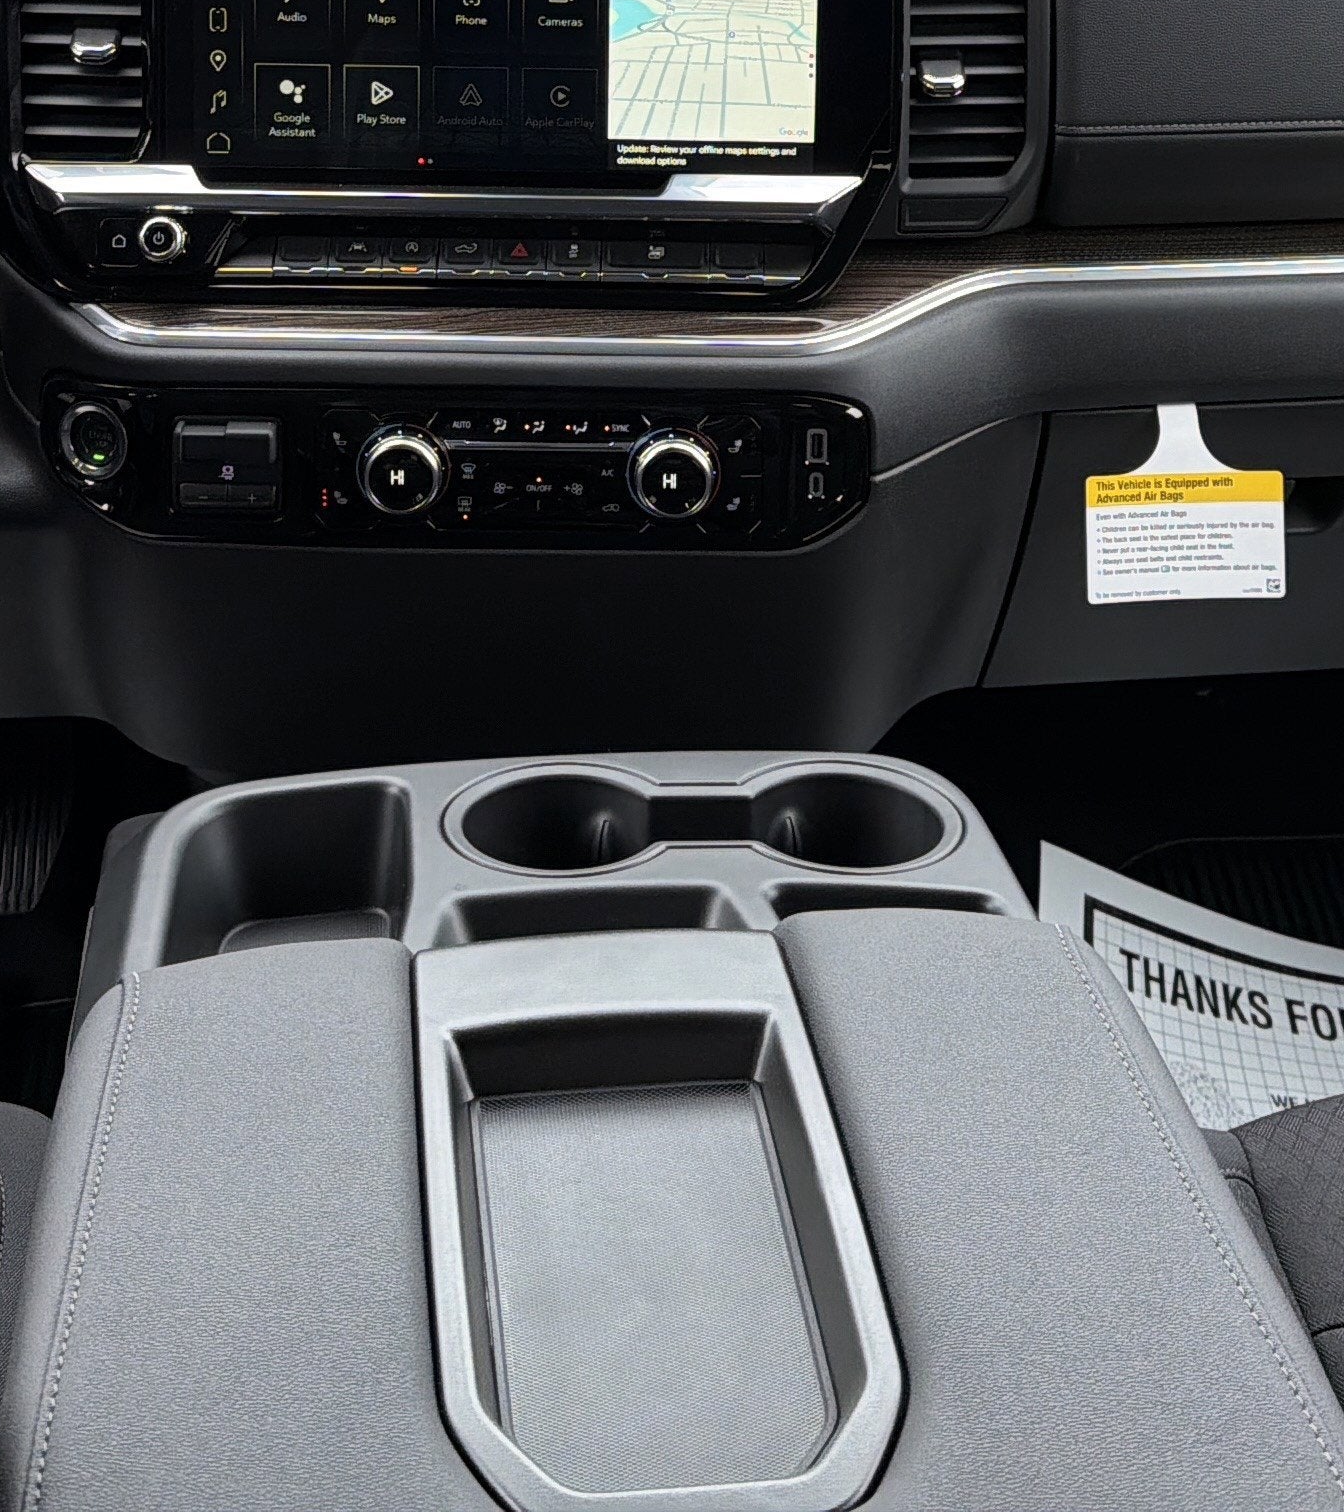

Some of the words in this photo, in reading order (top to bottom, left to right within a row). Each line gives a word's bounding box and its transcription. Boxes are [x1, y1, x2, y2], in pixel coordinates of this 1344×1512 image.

[277, 11, 307, 23] Audio
[368, 13, 397, 26] Maps
[455, 14, 488, 26] Phone
[538, 15, 584, 28] Cameras
[274, 113, 310, 126] Google
[357, 114, 379, 126] Play
[381, 114, 406, 125] Store
[438, 115, 477, 126] Android
[479, 116, 503, 126] Auto
[525, 117, 553, 129] Apple
[556, 117, 595, 129] CarPlay
[269, 126, 316, 138] Assistant
[778, 126, 809, 137] Google
[617, 144, 648, 155] Update:
[649, 145, 676, 155] Review
[678, 147, 697, 156] your
[698, 146, 724, 155] offline
[725, 147, 747, 156] maps
[749, 147, 780, 156] settings
[781, 147, 797, 156] and
[617, 156, 655, 165] download
[657, 157, 687, 166] options
[452, 421, 471, 430] AUTO
[611, 423, 630, 433] SYNC
[390, 469, 404, 486] HI
[601, 469, 614, 478] A/C
[662, 473, 677, 490] HI
[1096, 481, 1115, 492] This
[1118, 479, 1152, 491] Vehicle
[1154, 479, 1163, 489] is
[1165, 477, 1209, 491] Equipped
[1212, 477, 1233, 487] with
[525, 484, 552, 493] ON/OFF
[1096, 493, 1141, 504] Advanced
[1143, 491, 1157, 502] Air
[1160, 490, 1184, 502] Bags
[1128, 511, 1158, 519] Advanced
[1160, 510, 1169, 518] Air
[1171, 510, 1187, 518] Bags
[1118, 949, 1273, 1031] THANKS
